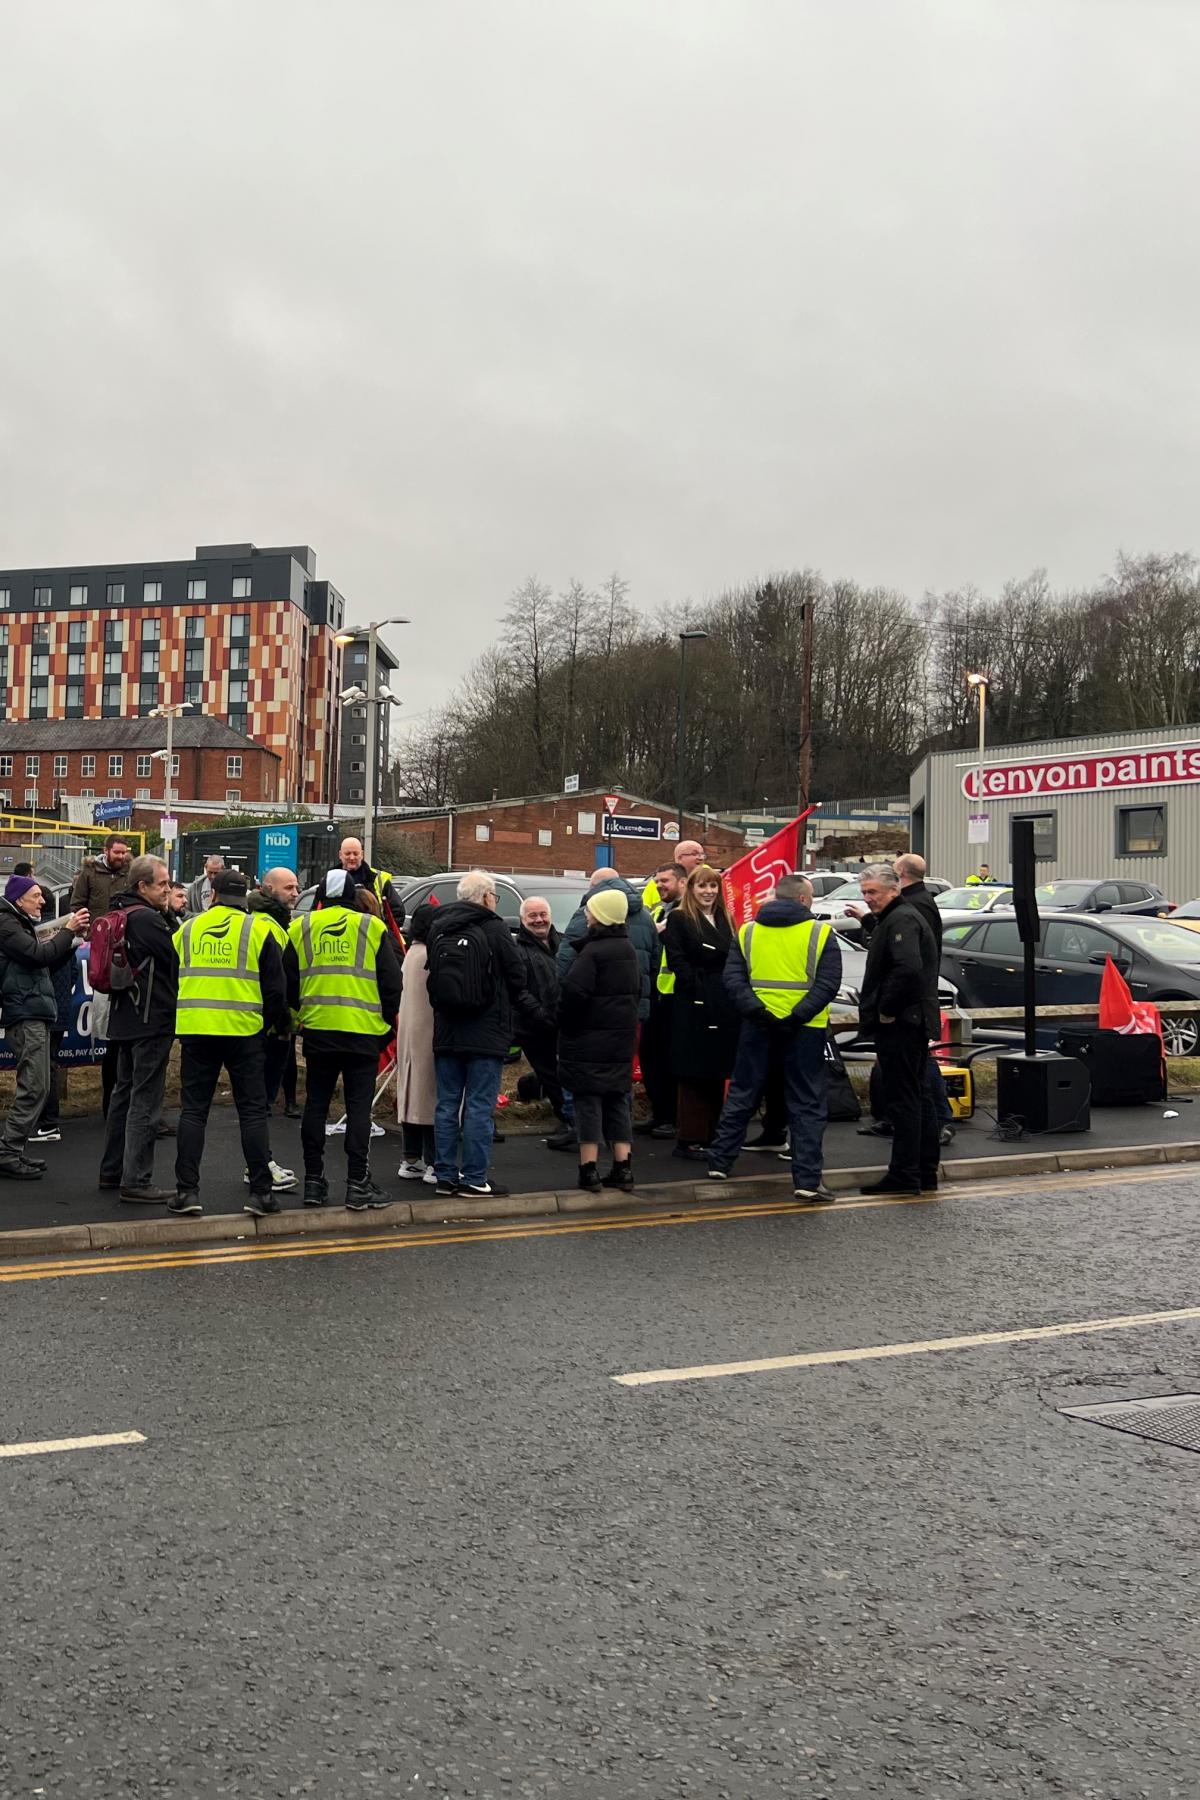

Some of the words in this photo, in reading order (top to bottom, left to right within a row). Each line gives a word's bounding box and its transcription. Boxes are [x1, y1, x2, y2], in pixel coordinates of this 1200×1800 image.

[971, 764, 1087, 794] kenyon
[1096, 750, 1200, 788] paints
[265, 833, 291, 847] hub
[58, 1049, 75, 1058] OBS,
[75, 1048, 88, 1057] PAY
